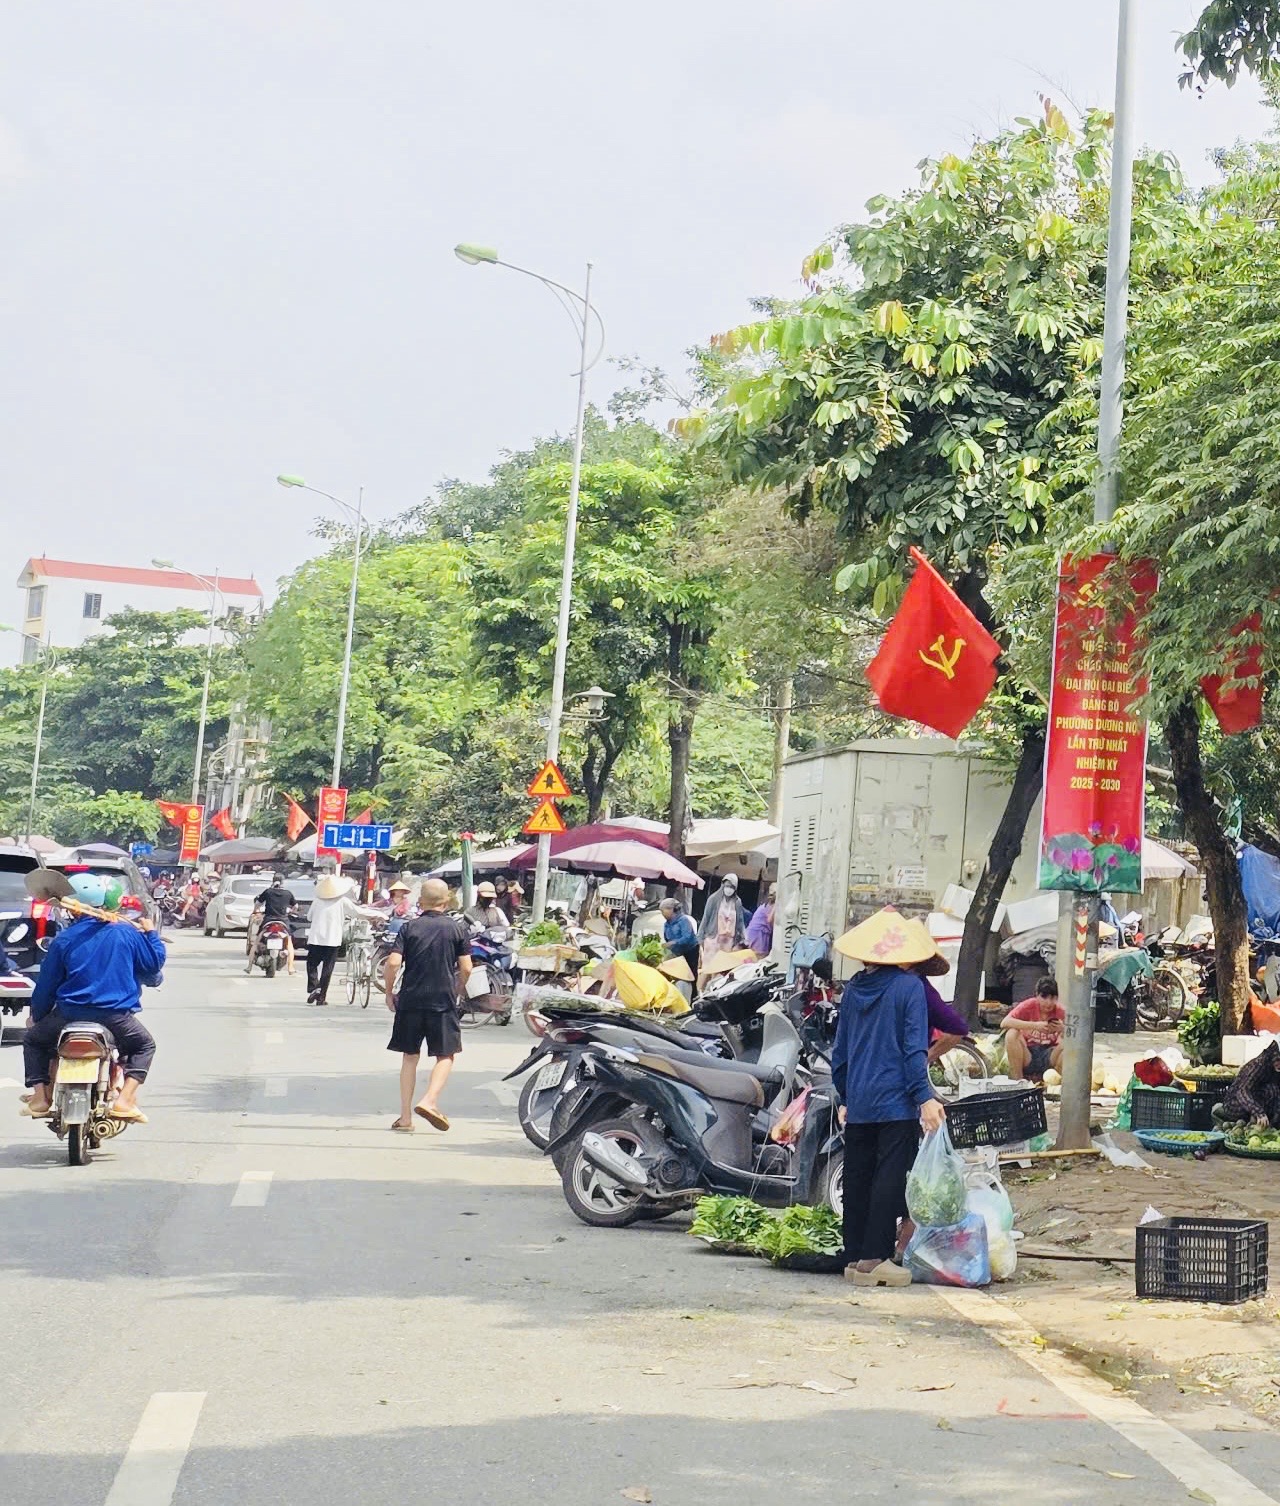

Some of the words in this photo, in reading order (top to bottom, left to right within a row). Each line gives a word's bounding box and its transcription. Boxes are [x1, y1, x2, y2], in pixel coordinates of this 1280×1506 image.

[1056, 715, 1093, 731] PHƯỜNG
[1070, 776, 1093, 790] 2025
[1101, 778, 1121, 791] 2030
